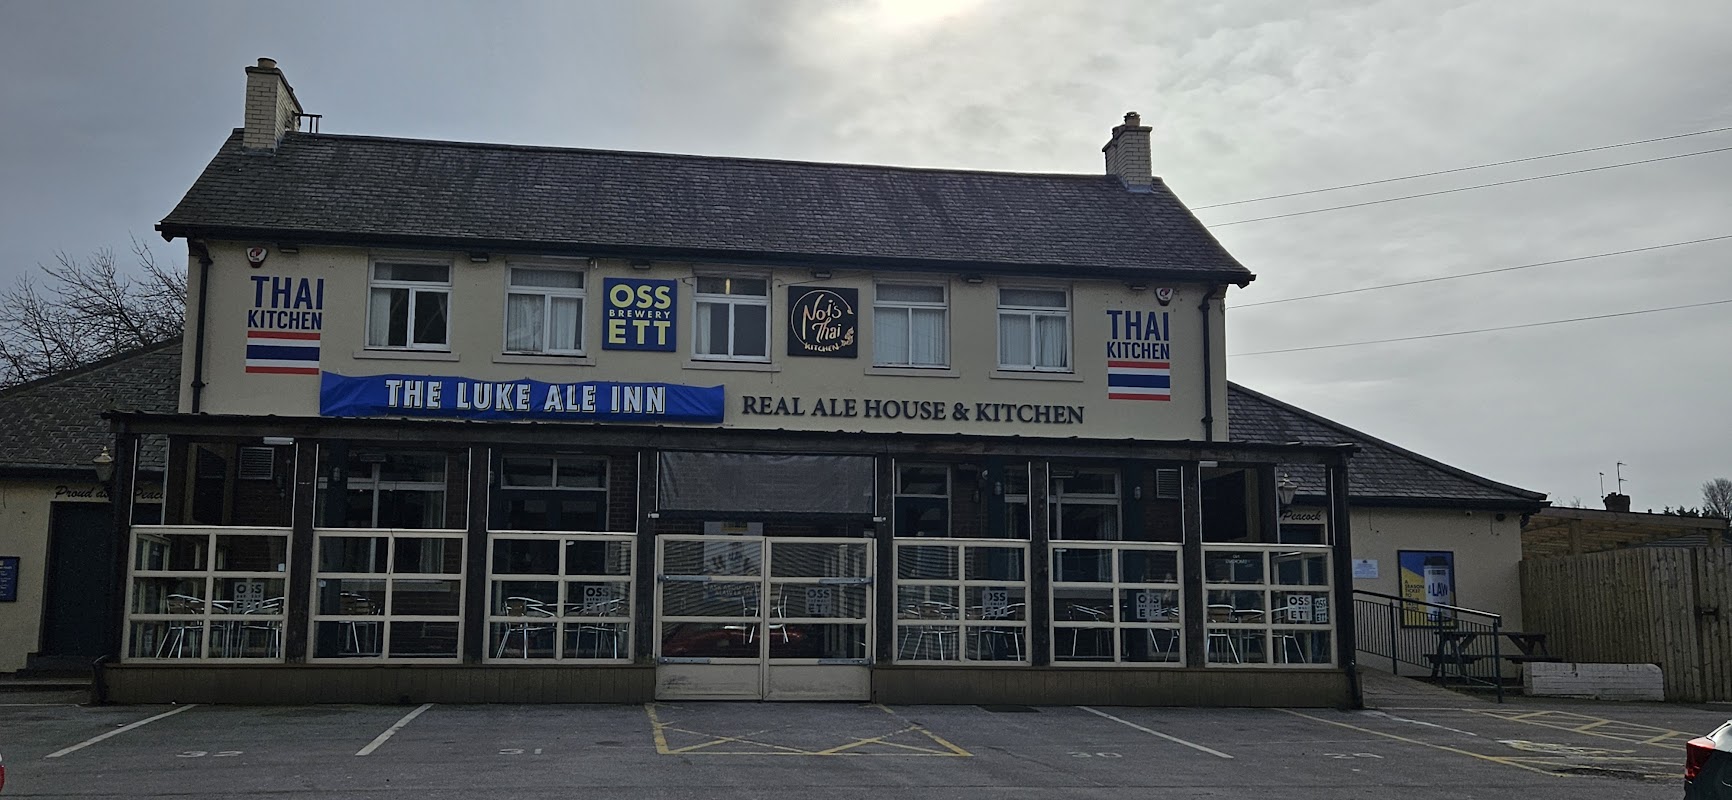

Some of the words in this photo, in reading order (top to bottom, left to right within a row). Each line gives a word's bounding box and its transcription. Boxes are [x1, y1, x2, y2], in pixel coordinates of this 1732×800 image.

[250, 275, 324, 310] THAI
[609, 283, 671, 310] OSS
[247, 309, 323, 330] KITCHEN
[608, 309, 671, 319] BREWERY
[802, 293, 843, 341] Noi's
[608, 319, 671, 346] ETT
[811, 316, 843, 344] Thai
[1106, 310, 1170, 341] THAI
[803, 341, 840, 353] KITCHEN
[1106, 341, 1170, 360] KITCHEN
[385, 379, 442, 409] THE
[456, 382, 531, 412] LUKE
[543, 384, 597, 414] ALE
[610, 385, 666, 415] INN
[742, 396, 806, 416] REAL
[810, 397, 858, 417] ALE
[863, 398, 946, 420] HOUSE
[952, 402, 970, 421] &
[974, 402, 1085, 424] KITCHEN
[54, 485, 94, 498] Proud
[1283, 510, 1322, 521] Peacock
[586, 587, 609, 596] OSS
[807, 589, 830, 599] OSS
[1289, 597, 1310, 606] OSS
